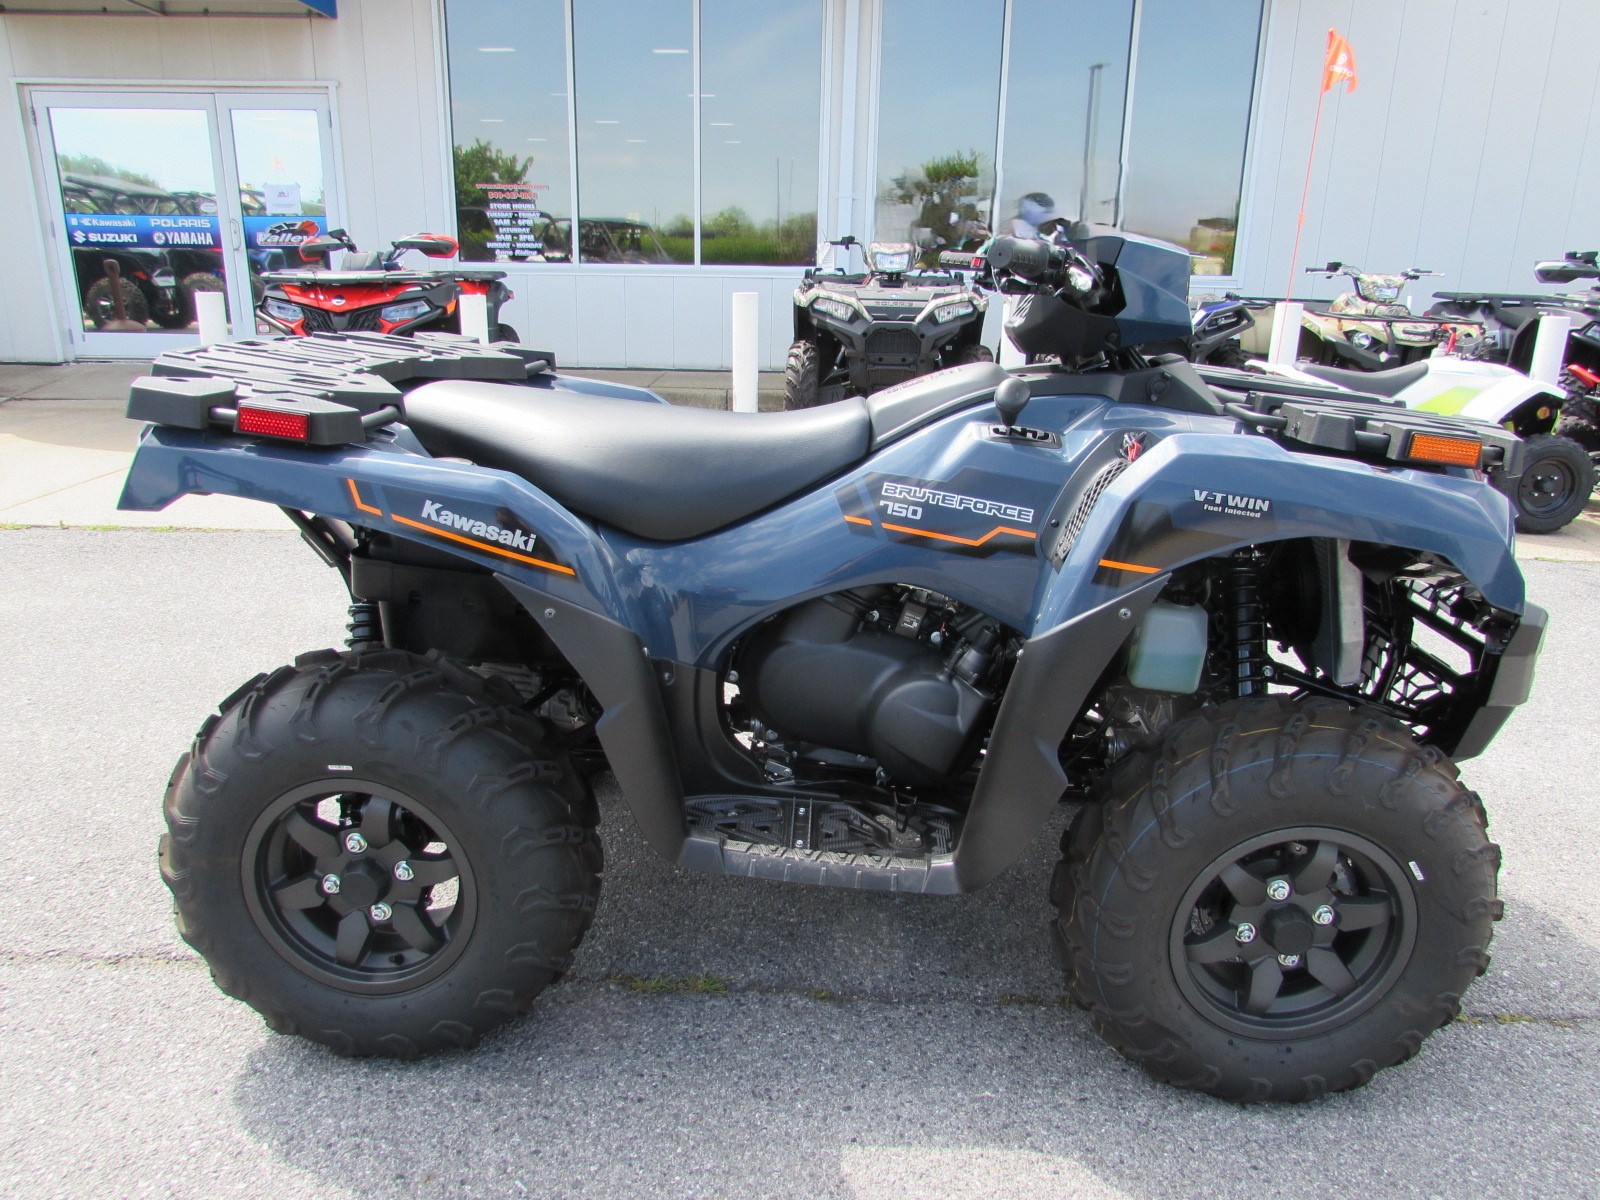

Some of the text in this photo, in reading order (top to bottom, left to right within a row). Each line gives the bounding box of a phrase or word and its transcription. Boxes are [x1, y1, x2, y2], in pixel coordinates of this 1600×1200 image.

[92, 218, 211, 228] Kawasaki POLARIS
[88, 231, 214, 245] SUZUKI YAMAHA
[1193, 489, 1270, 512] V-TWIN
[1203, 503, 1222, 512] Fuel
[879, 499, 923, 520] 750
[421, 499, 537, 552] Kawasaki
